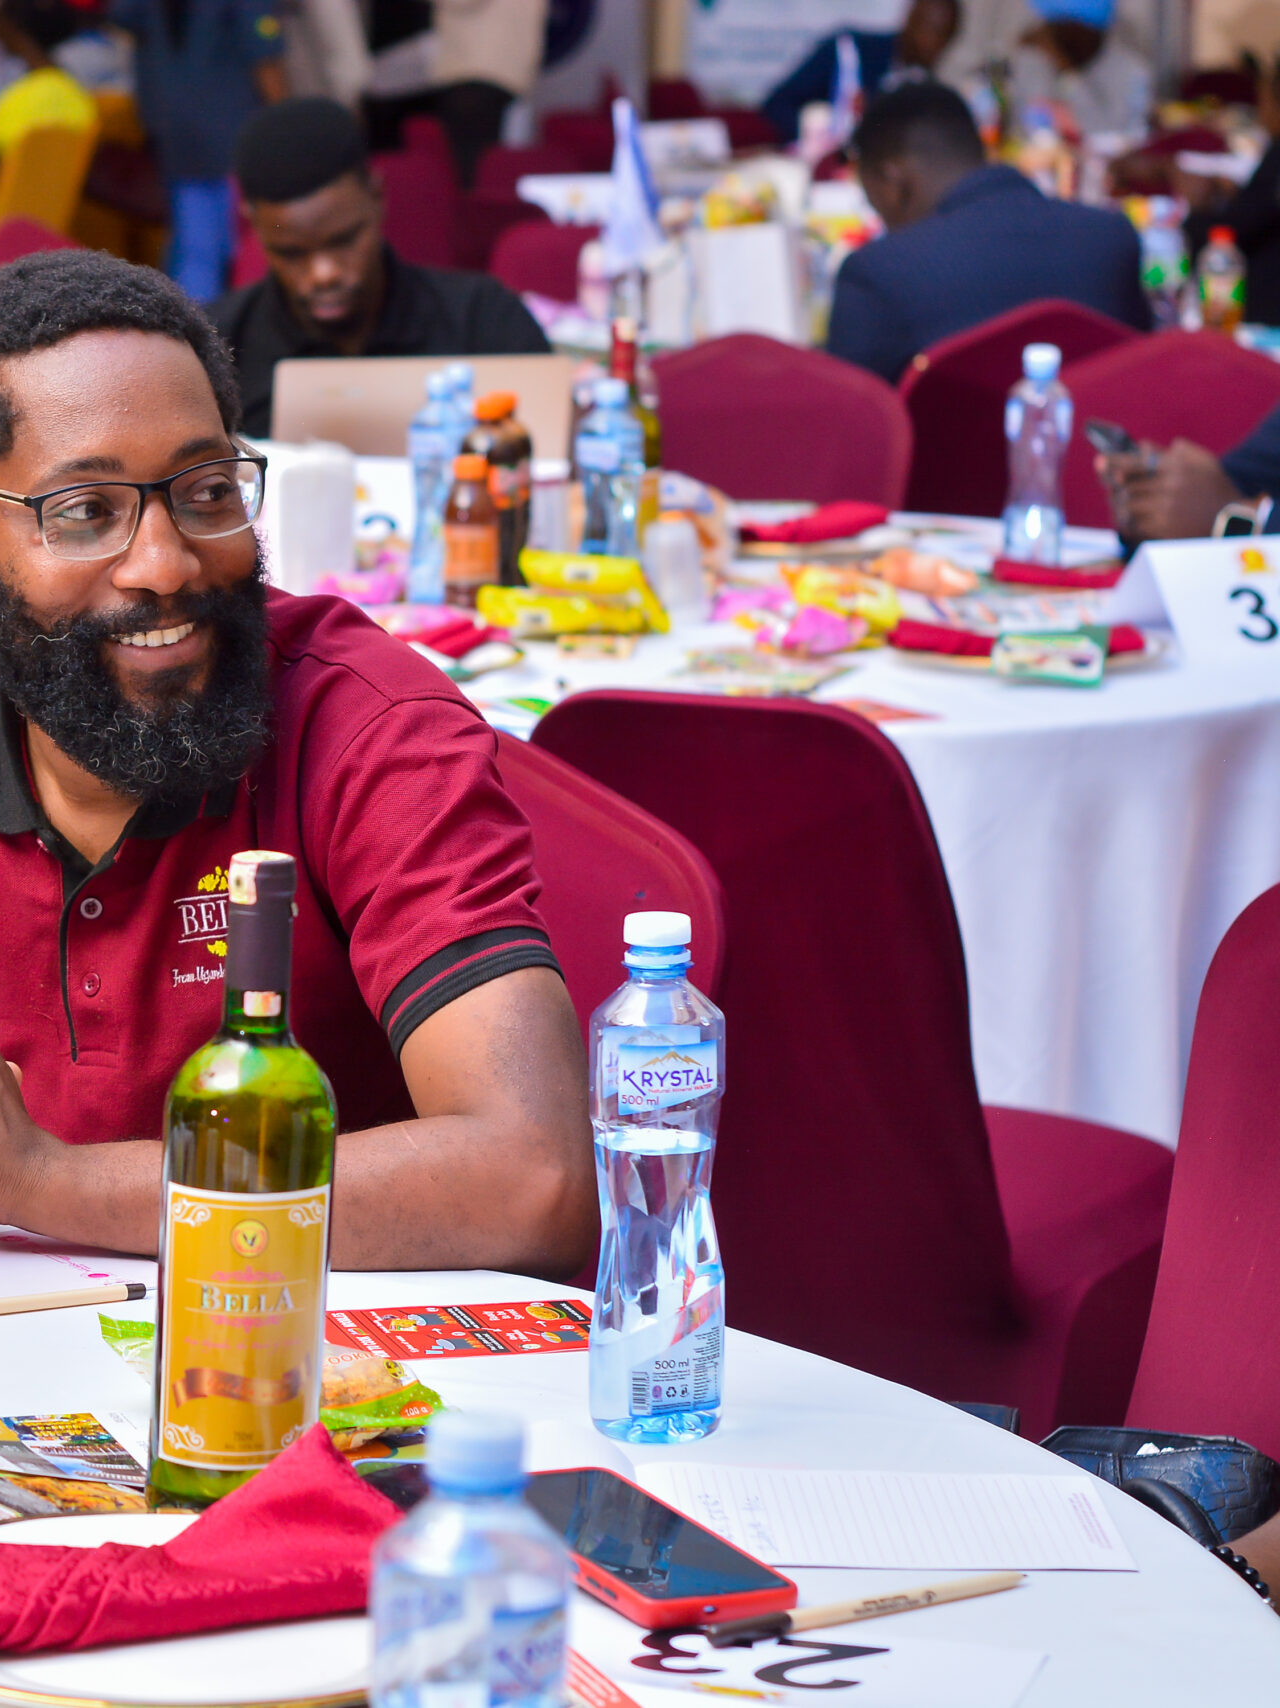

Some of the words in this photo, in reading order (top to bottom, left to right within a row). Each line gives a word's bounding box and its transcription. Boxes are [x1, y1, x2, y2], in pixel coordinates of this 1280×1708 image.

[177, 899, 230, 938] BEL
[623, 1066, 714, 1097] KRYSTAL
[621, 1095, 644, 1106] 500
[646, 1095, 660, 1106] ml
[200, 1284, 296, 1313] BELLA
[655, 1360, 676, 1370] 500
[678, 1358, 690, 1368] ml
[405, 1407, 419, 1417] 100
